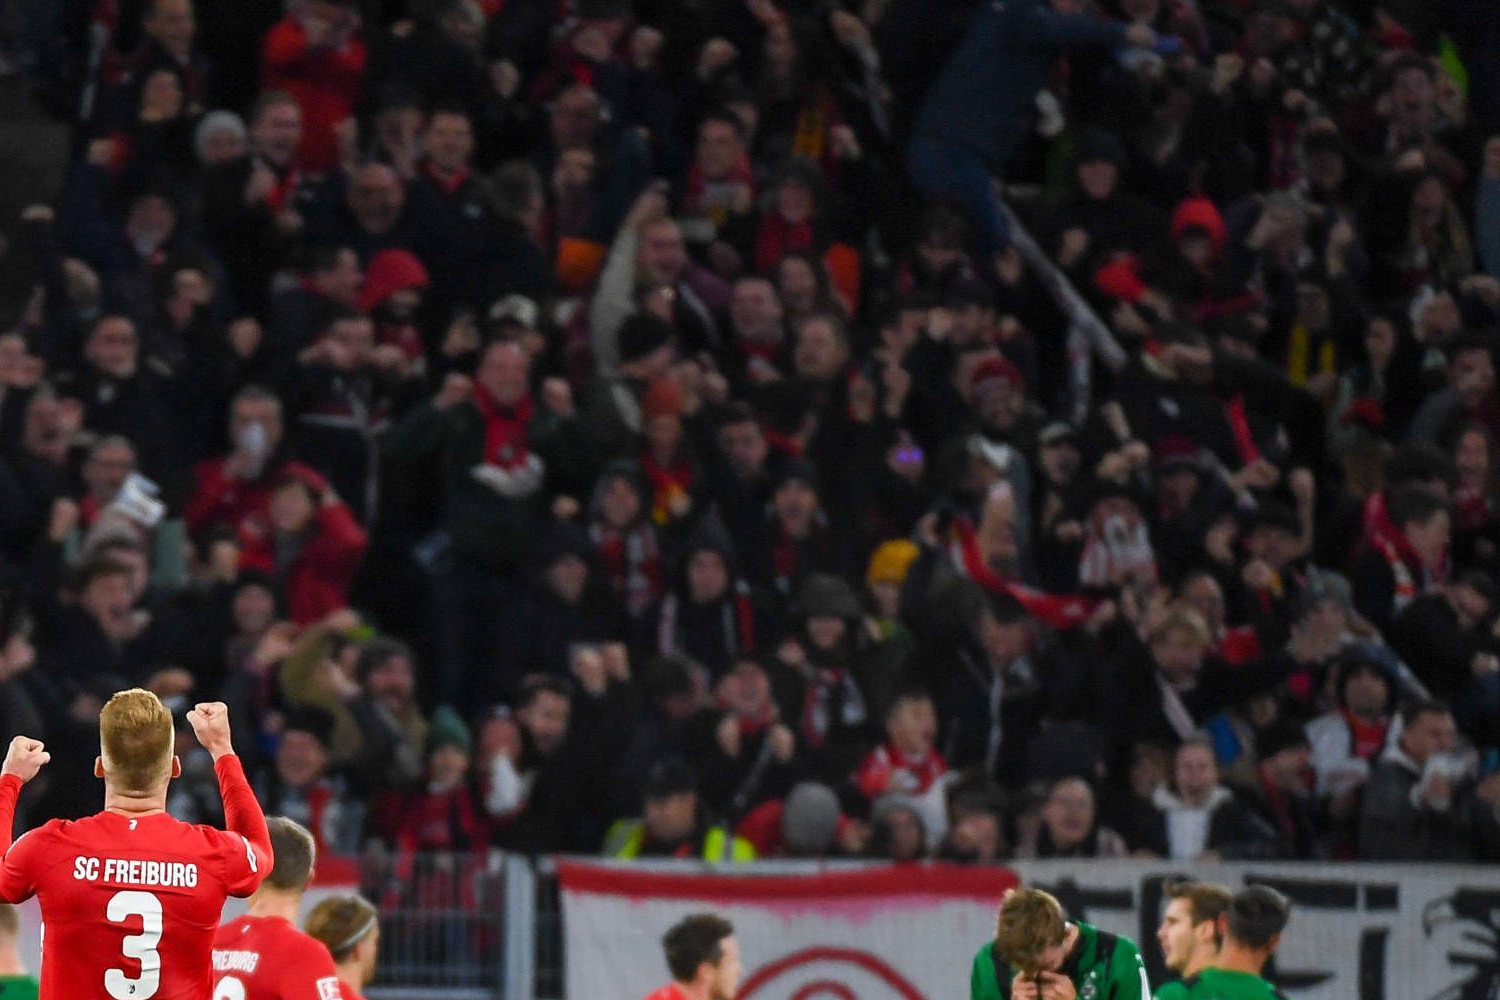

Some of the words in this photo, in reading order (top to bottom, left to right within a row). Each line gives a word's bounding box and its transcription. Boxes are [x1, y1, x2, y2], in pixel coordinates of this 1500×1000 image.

[73, 856, 100, 881] SC
[103, 858, 198, 887] FREIBURG
[104, 890, 163, 1000] 3
